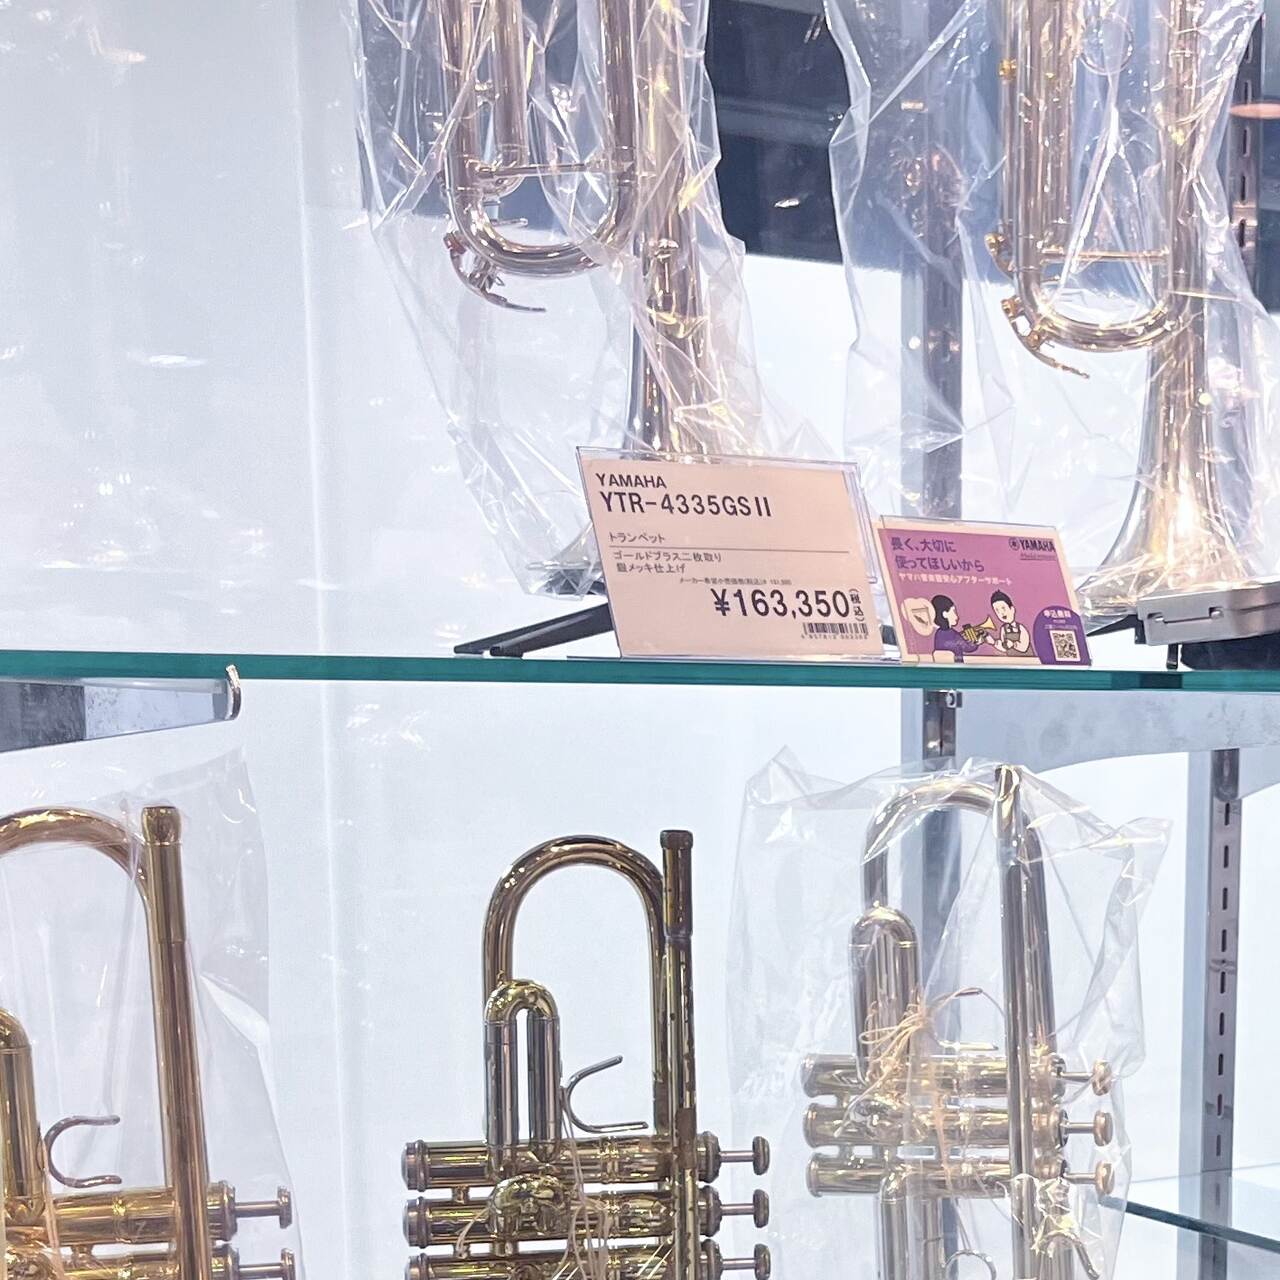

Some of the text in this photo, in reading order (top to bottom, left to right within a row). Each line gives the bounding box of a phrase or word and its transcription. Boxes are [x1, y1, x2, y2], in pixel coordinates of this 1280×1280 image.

[596, 472, 667, 489] YAMAHA
[609, 532, 666, 545] トランペット
[891, 537, 957, 553] 長く、大切に
[1020, 538, 1056, 552] YAMAHA
[895, 555, 985, 572] 使ってほしいから
[710, 587, 850, 619] ¥163,350
